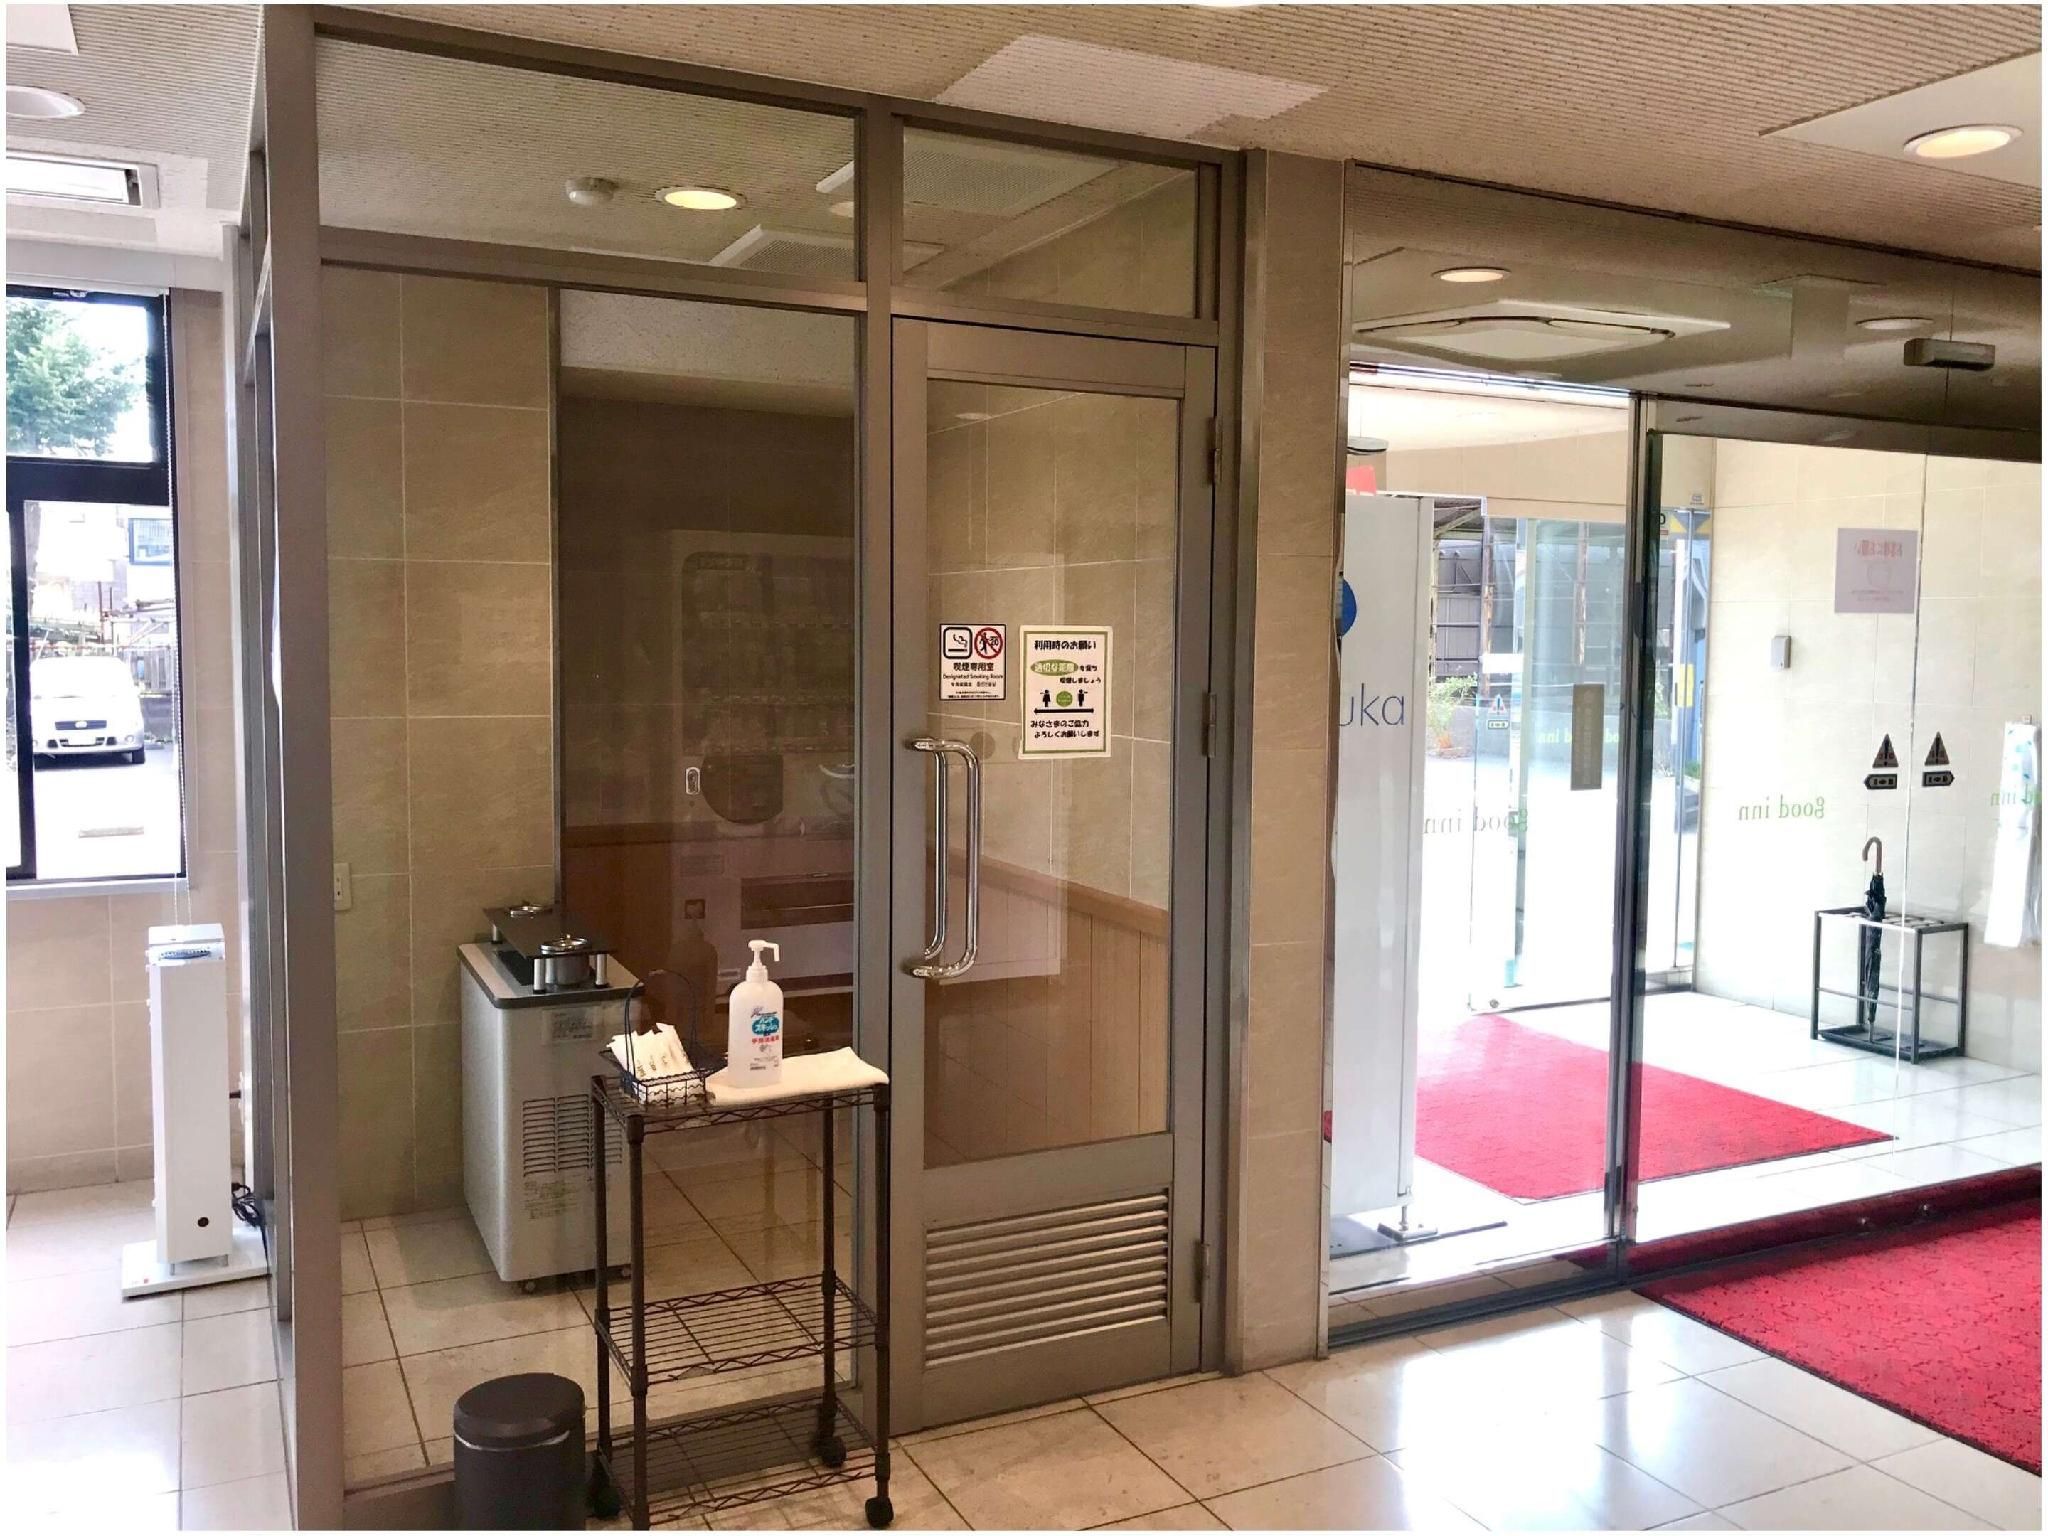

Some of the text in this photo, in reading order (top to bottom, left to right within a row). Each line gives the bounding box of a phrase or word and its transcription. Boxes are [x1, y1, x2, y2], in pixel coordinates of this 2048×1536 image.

[1034, 640, 1097, 651] 利用時のお願い
[953, 662, 994, 671] 喫煙専用室
